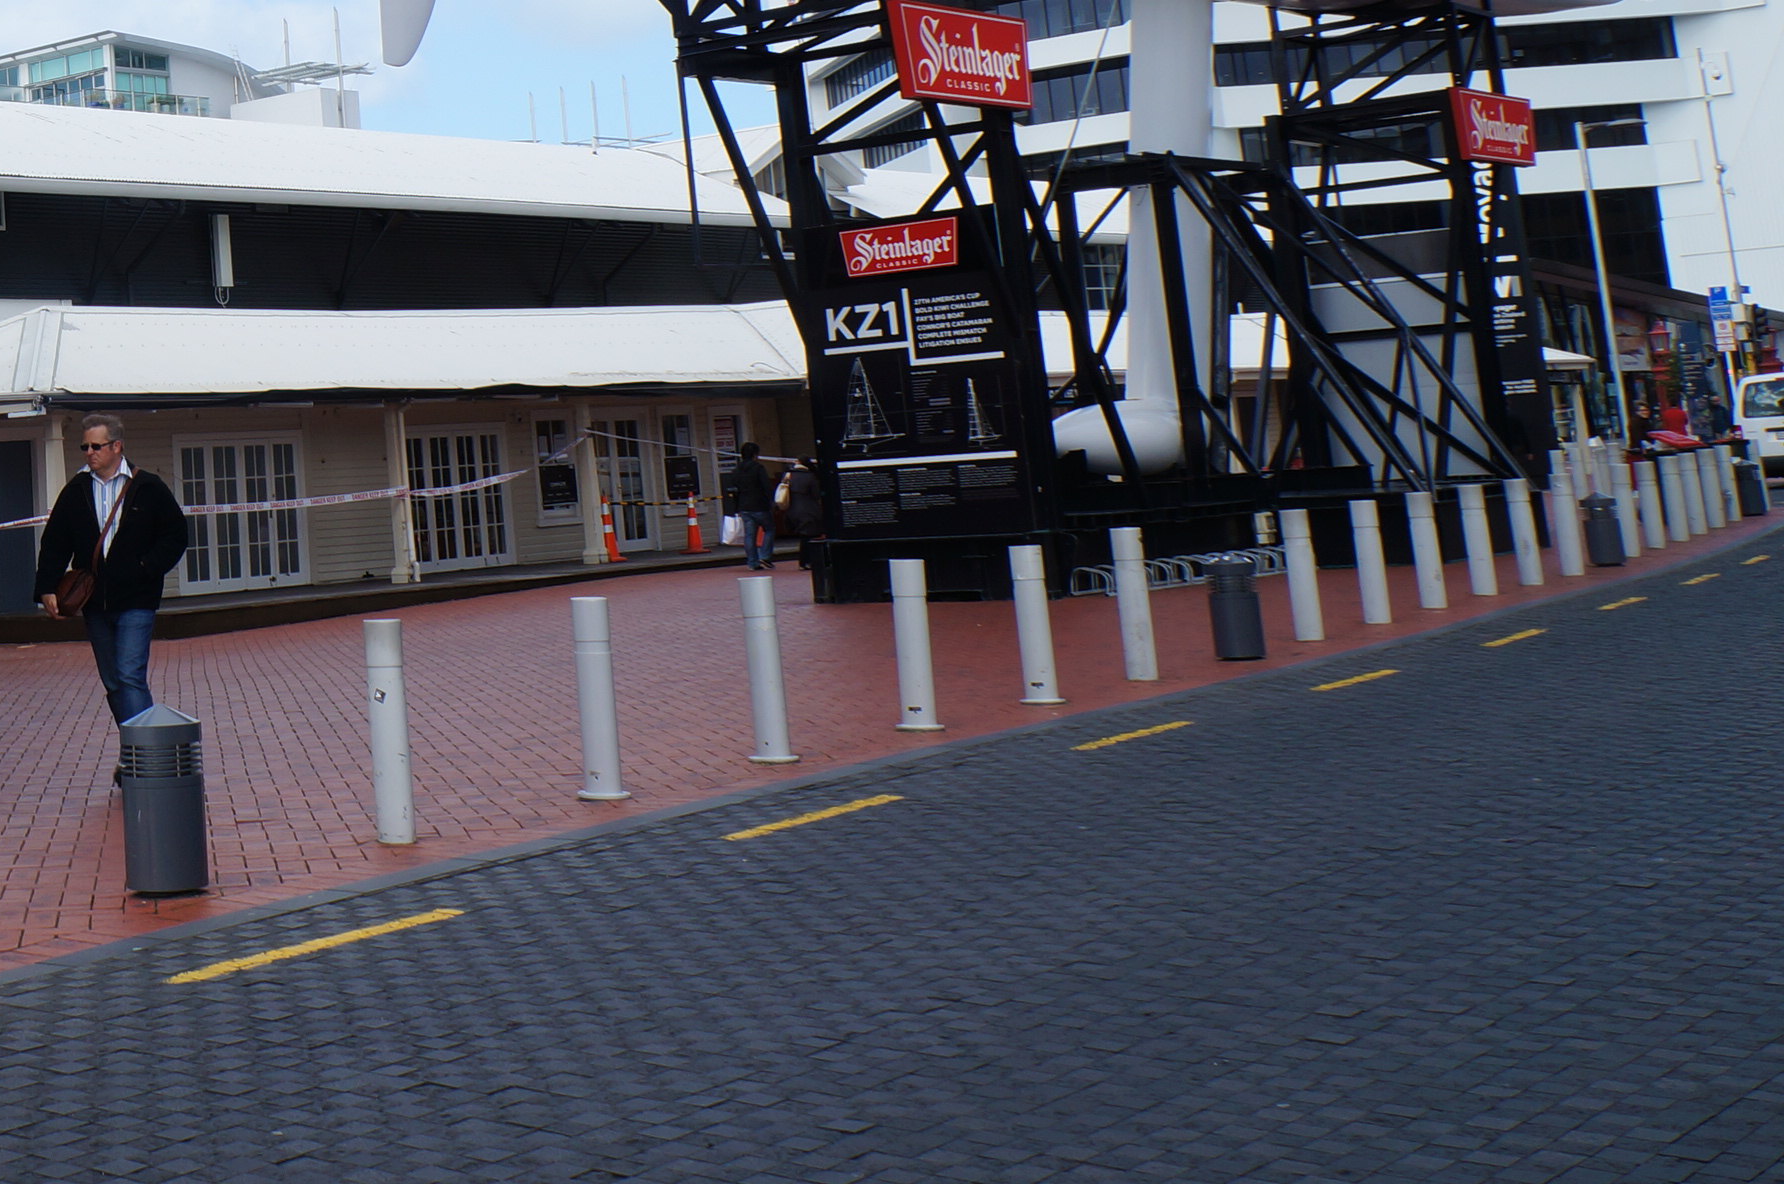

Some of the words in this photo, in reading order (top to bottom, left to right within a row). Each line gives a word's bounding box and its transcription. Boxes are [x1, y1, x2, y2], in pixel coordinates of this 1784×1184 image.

[918, 15, 1021, 96] Steinlager
[946, 78, 991, 92] CLASSIC
[850, 227, 952, 271] Steinlager
[875, 258, 918, 269] CLASSIC
[931, 293, 966, 304] AMERICA'S
[966, 292, 981, 300] CUP
[950, 300, 990, 311] CHALLENGE
[824, 300, 900, 342] KZ1
[951, 317, 993, 328] CATAMARAN
[918, 330, 952, 340] COMPLETE
[953, 327, 988, 337] MISMATCH
